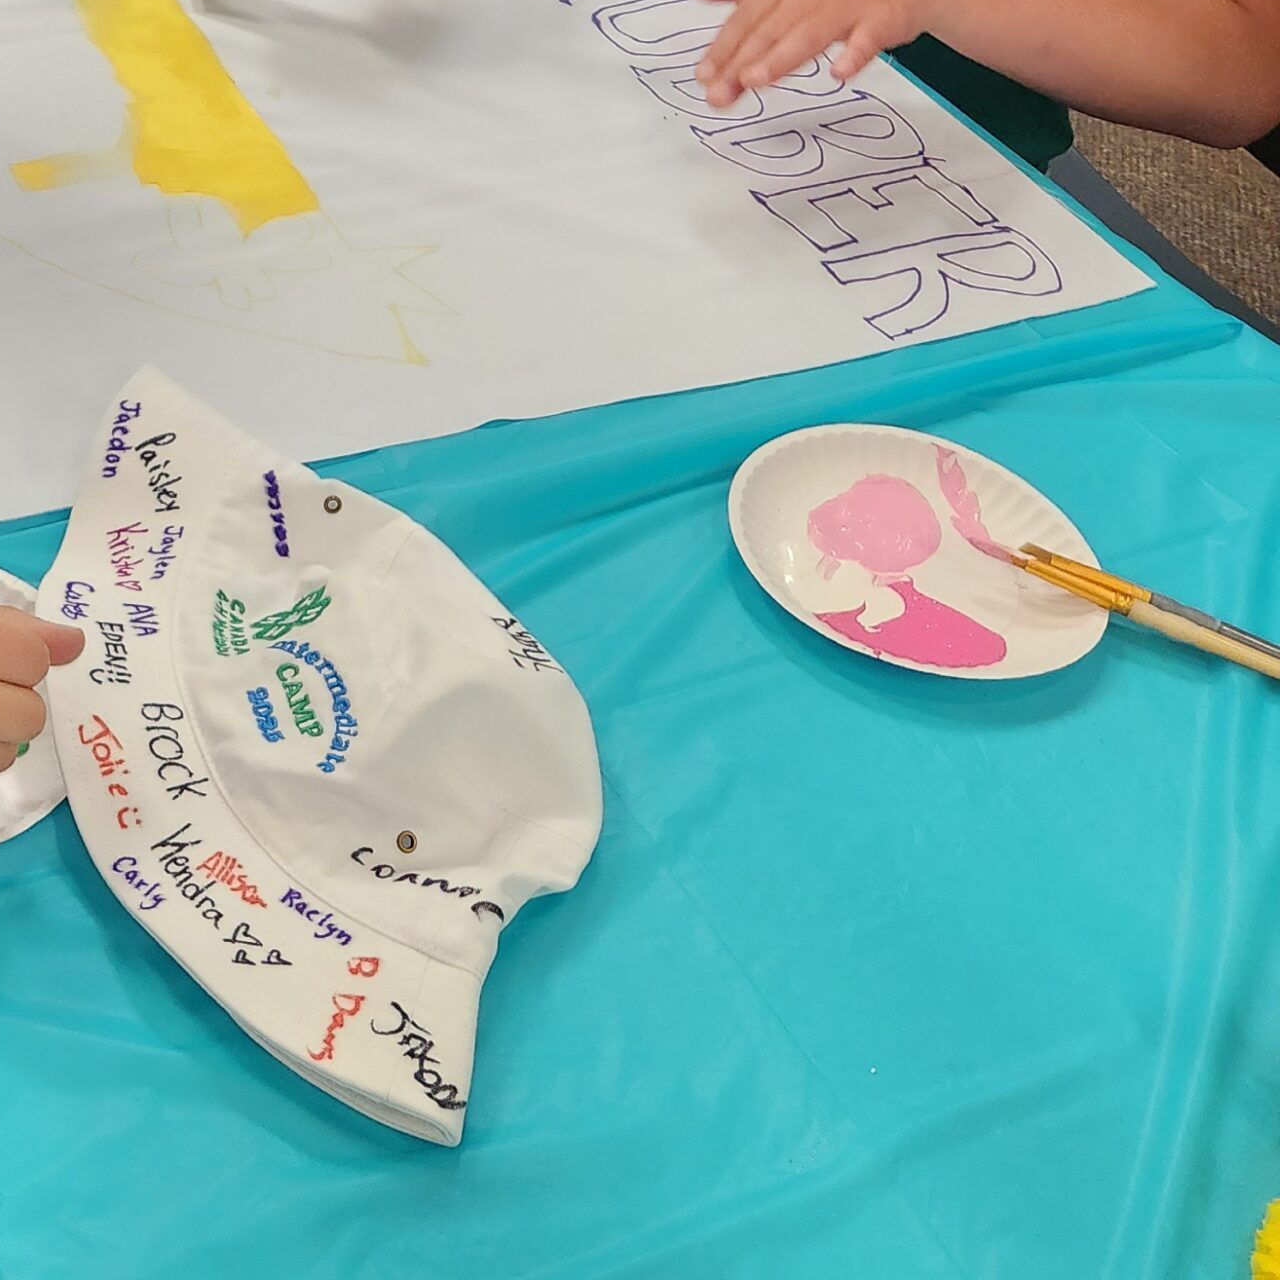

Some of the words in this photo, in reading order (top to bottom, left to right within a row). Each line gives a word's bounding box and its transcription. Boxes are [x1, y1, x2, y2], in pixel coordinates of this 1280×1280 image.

[102, 400, 141, 478] Jaedon
[135, 432, 182, 512] Paisley
[148, 525, 184, 579] Jaylen
[123, 602, 159, 637] AVA
[246, 687, 286, 743] 2025
[276, 662, 324, 738] CAMP
[112, 856, 168, 911] Carly
[150, 822, 224, 929] Kendra
